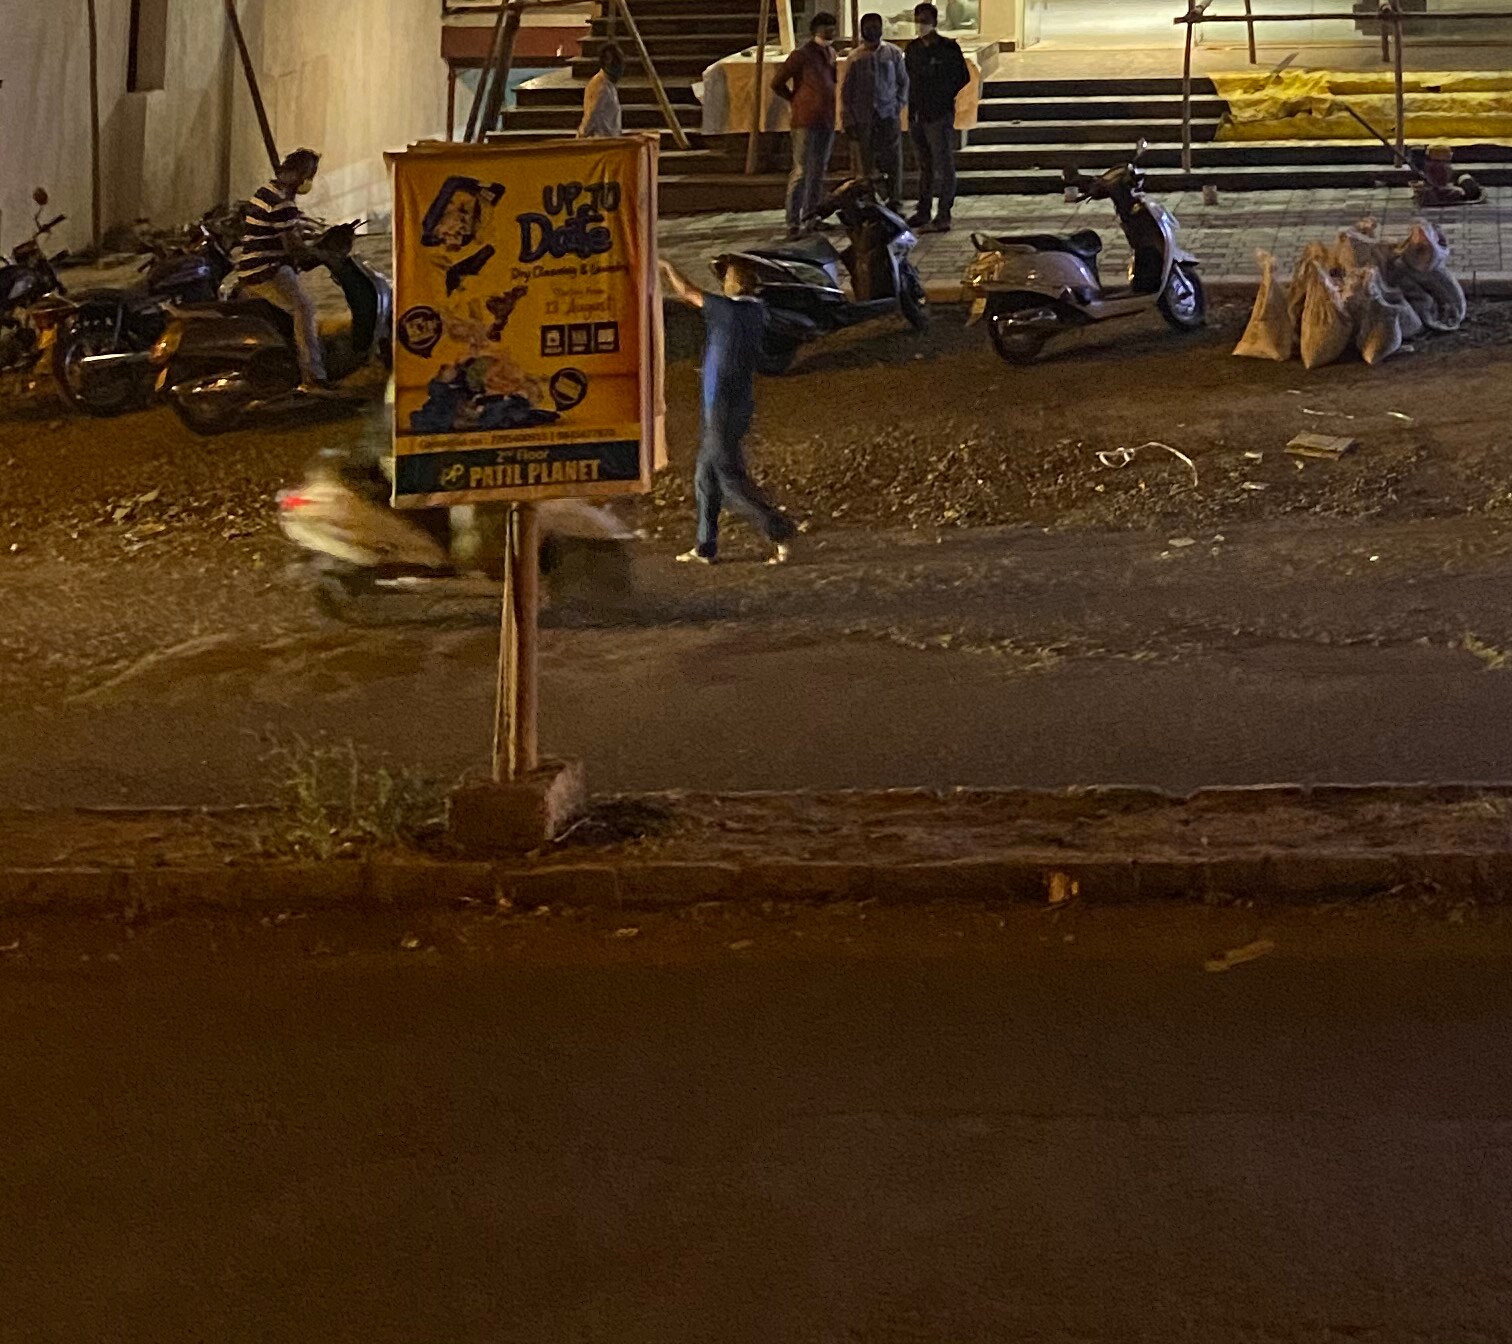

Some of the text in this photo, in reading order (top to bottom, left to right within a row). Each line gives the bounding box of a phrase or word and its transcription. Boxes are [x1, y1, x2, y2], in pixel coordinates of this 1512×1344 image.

[543, 181, 583, 216] UP
[516, 203, 613, 263] Date
[469, 464, 522, 488] PATIL
[527, 459, 601, 484] PLANET
